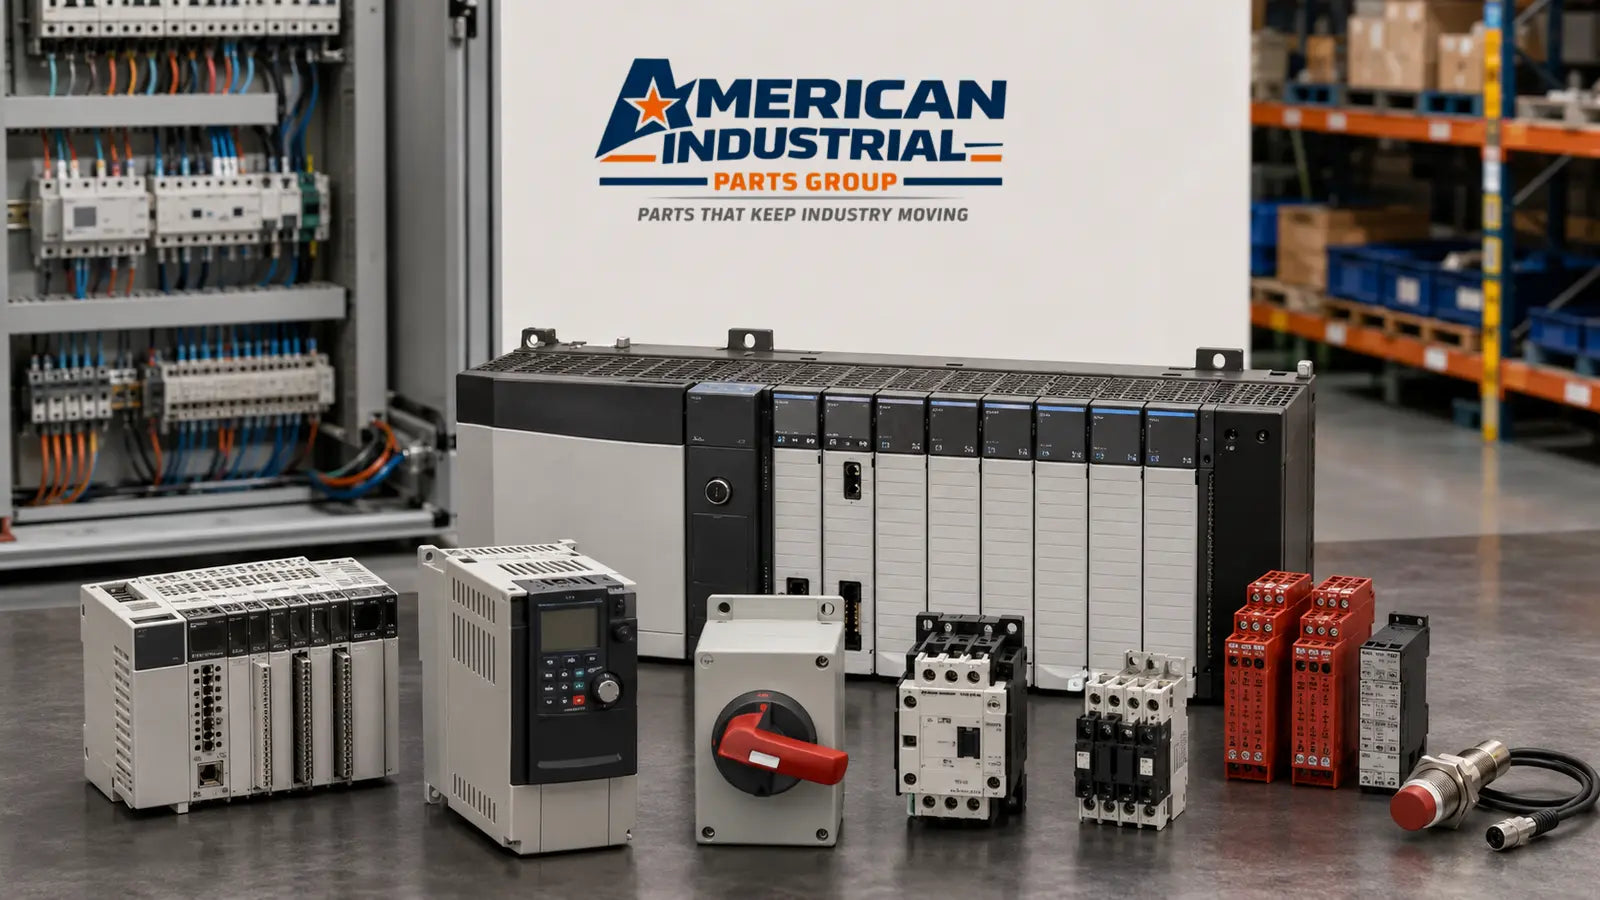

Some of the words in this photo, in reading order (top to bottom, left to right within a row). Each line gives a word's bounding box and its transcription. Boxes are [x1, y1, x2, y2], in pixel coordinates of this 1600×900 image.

[595, 58, 1007, 158] AMERICAN
[662, 127, 967, 164] INDUSTRIAL
[714, 172, 797, 191] PARTS
[806, 172, 897, 191] GROUP
[638, 207, 695, 222] PARTS
[701, 207, 746, 222] THAT
[750, 207, 796, 222] KEEP
[801, 207, 893, 222] INDUSTRY
[898, 207, 969, 222] MOVING
